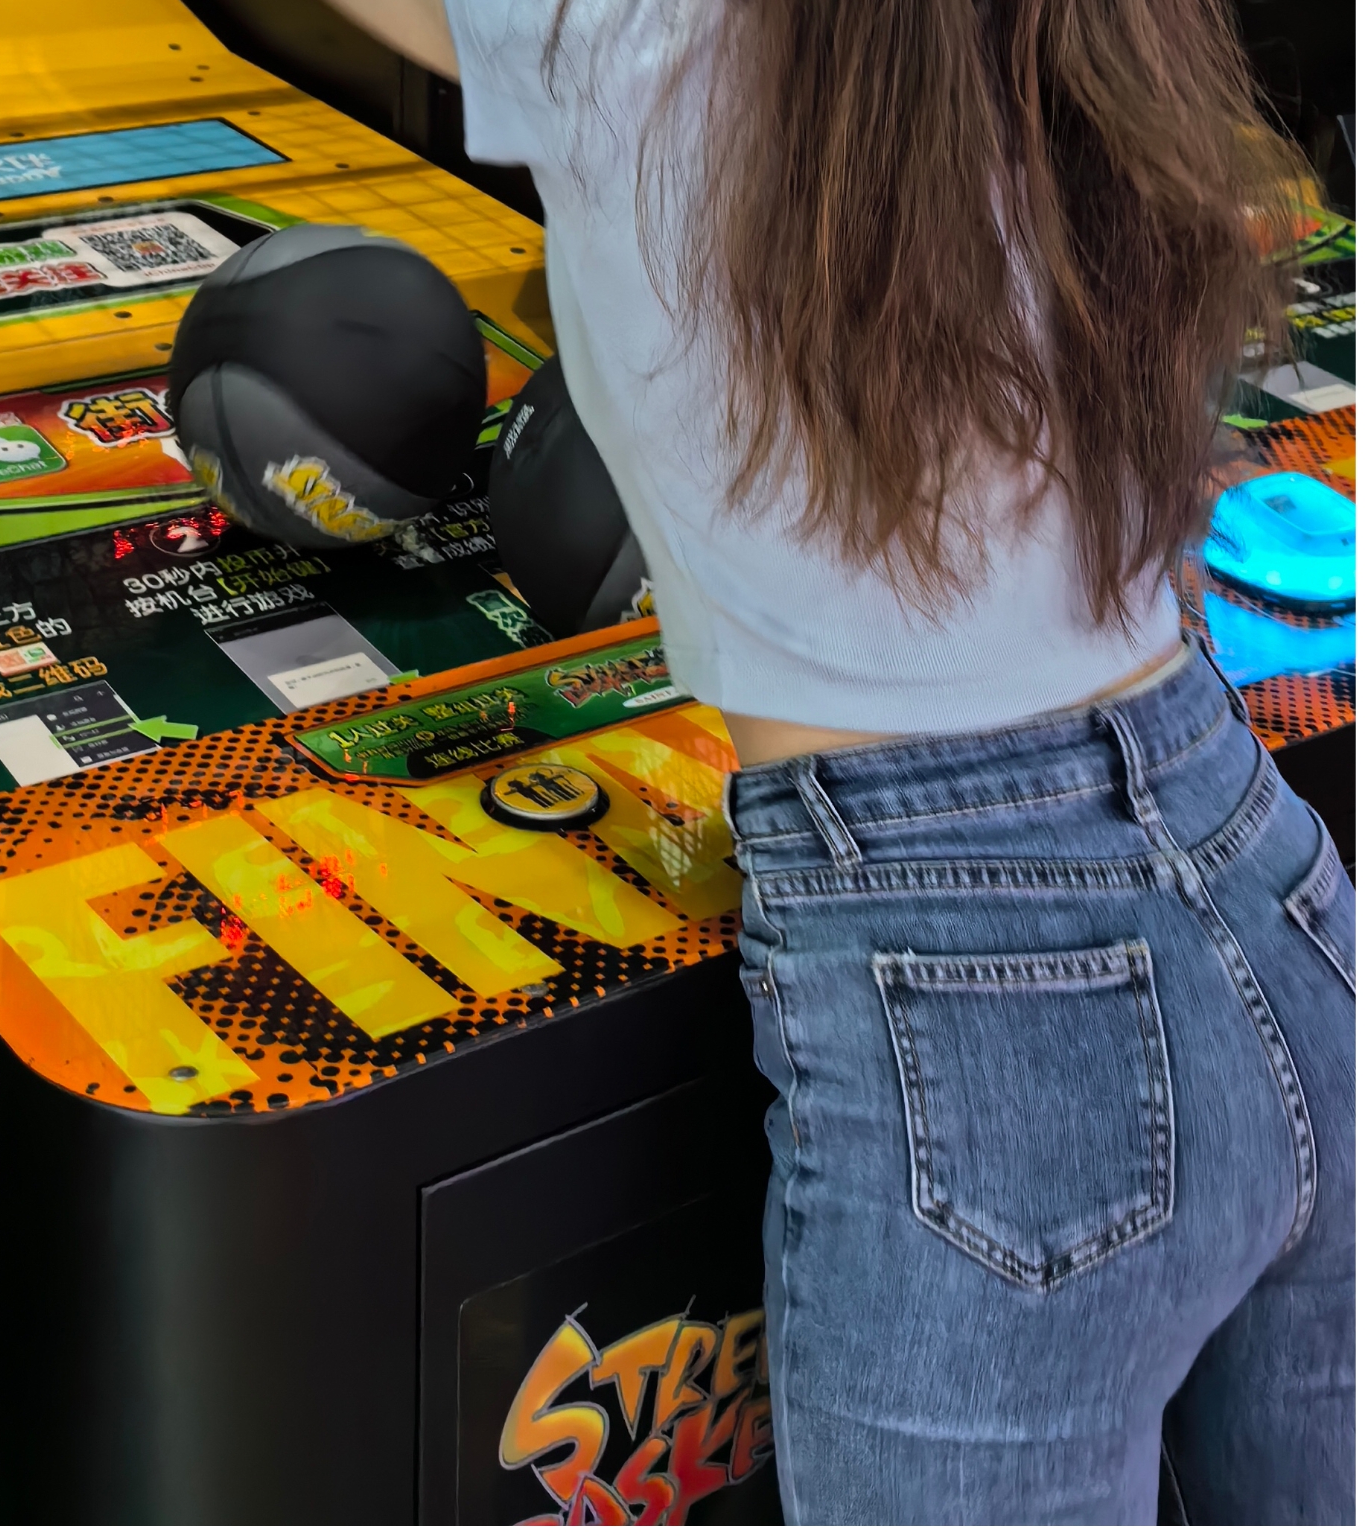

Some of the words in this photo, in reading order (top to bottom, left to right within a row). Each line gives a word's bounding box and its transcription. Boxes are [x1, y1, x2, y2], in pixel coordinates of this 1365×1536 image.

[168, 525, 210, 553] 2
[192, 583, 316, 626] 进行游戏
[498, 1296, 770, 1511] STRE
